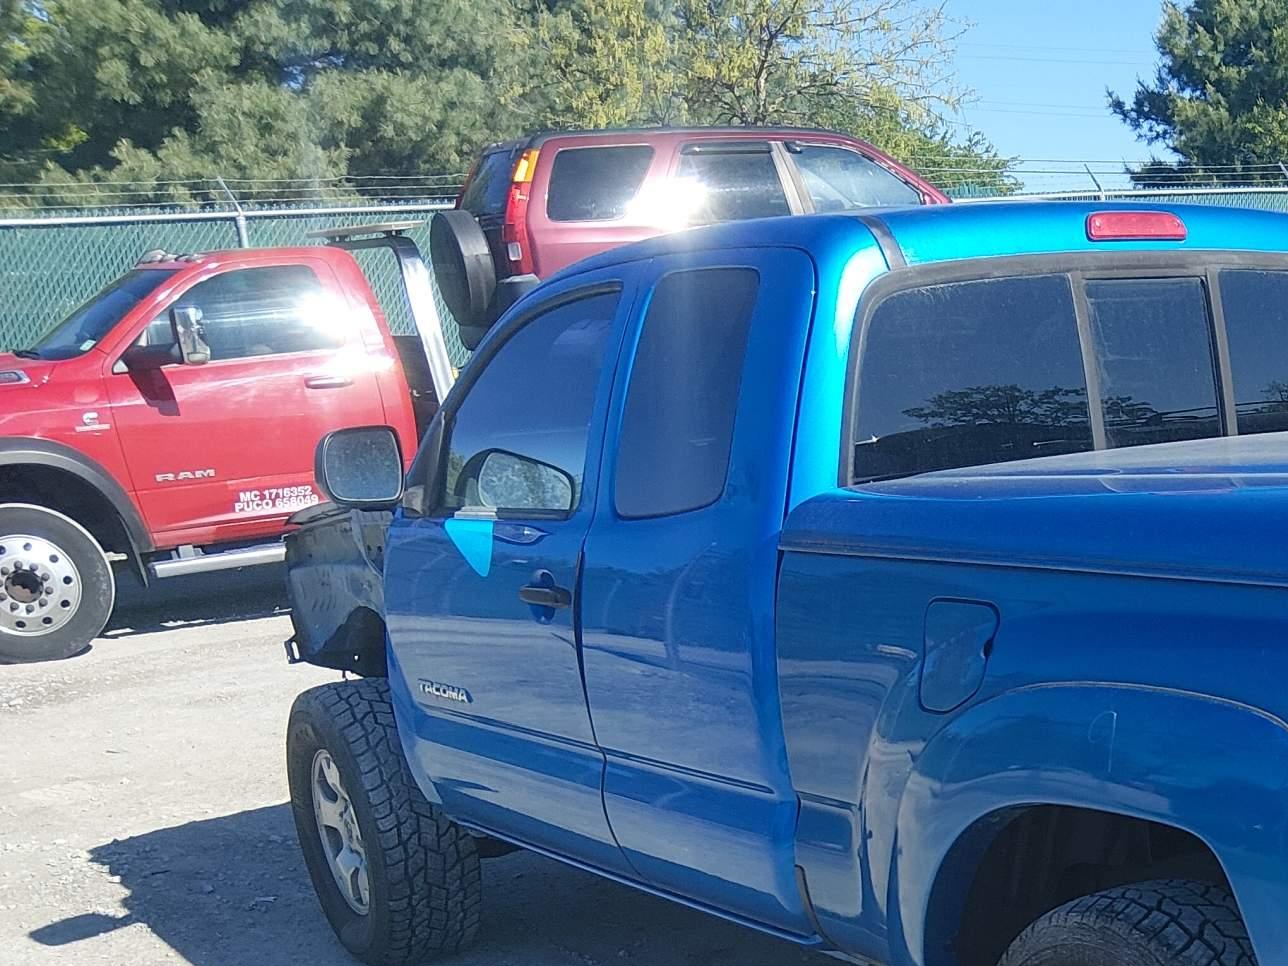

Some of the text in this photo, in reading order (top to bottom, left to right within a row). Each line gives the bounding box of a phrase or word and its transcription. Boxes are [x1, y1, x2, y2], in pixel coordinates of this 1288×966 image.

[155, 469, 216, 482] RAM
[239, 491, 261, 502] MC
[234, 500, 273, 513] PUCO
[418, 679, 474, 704] TACOMA
